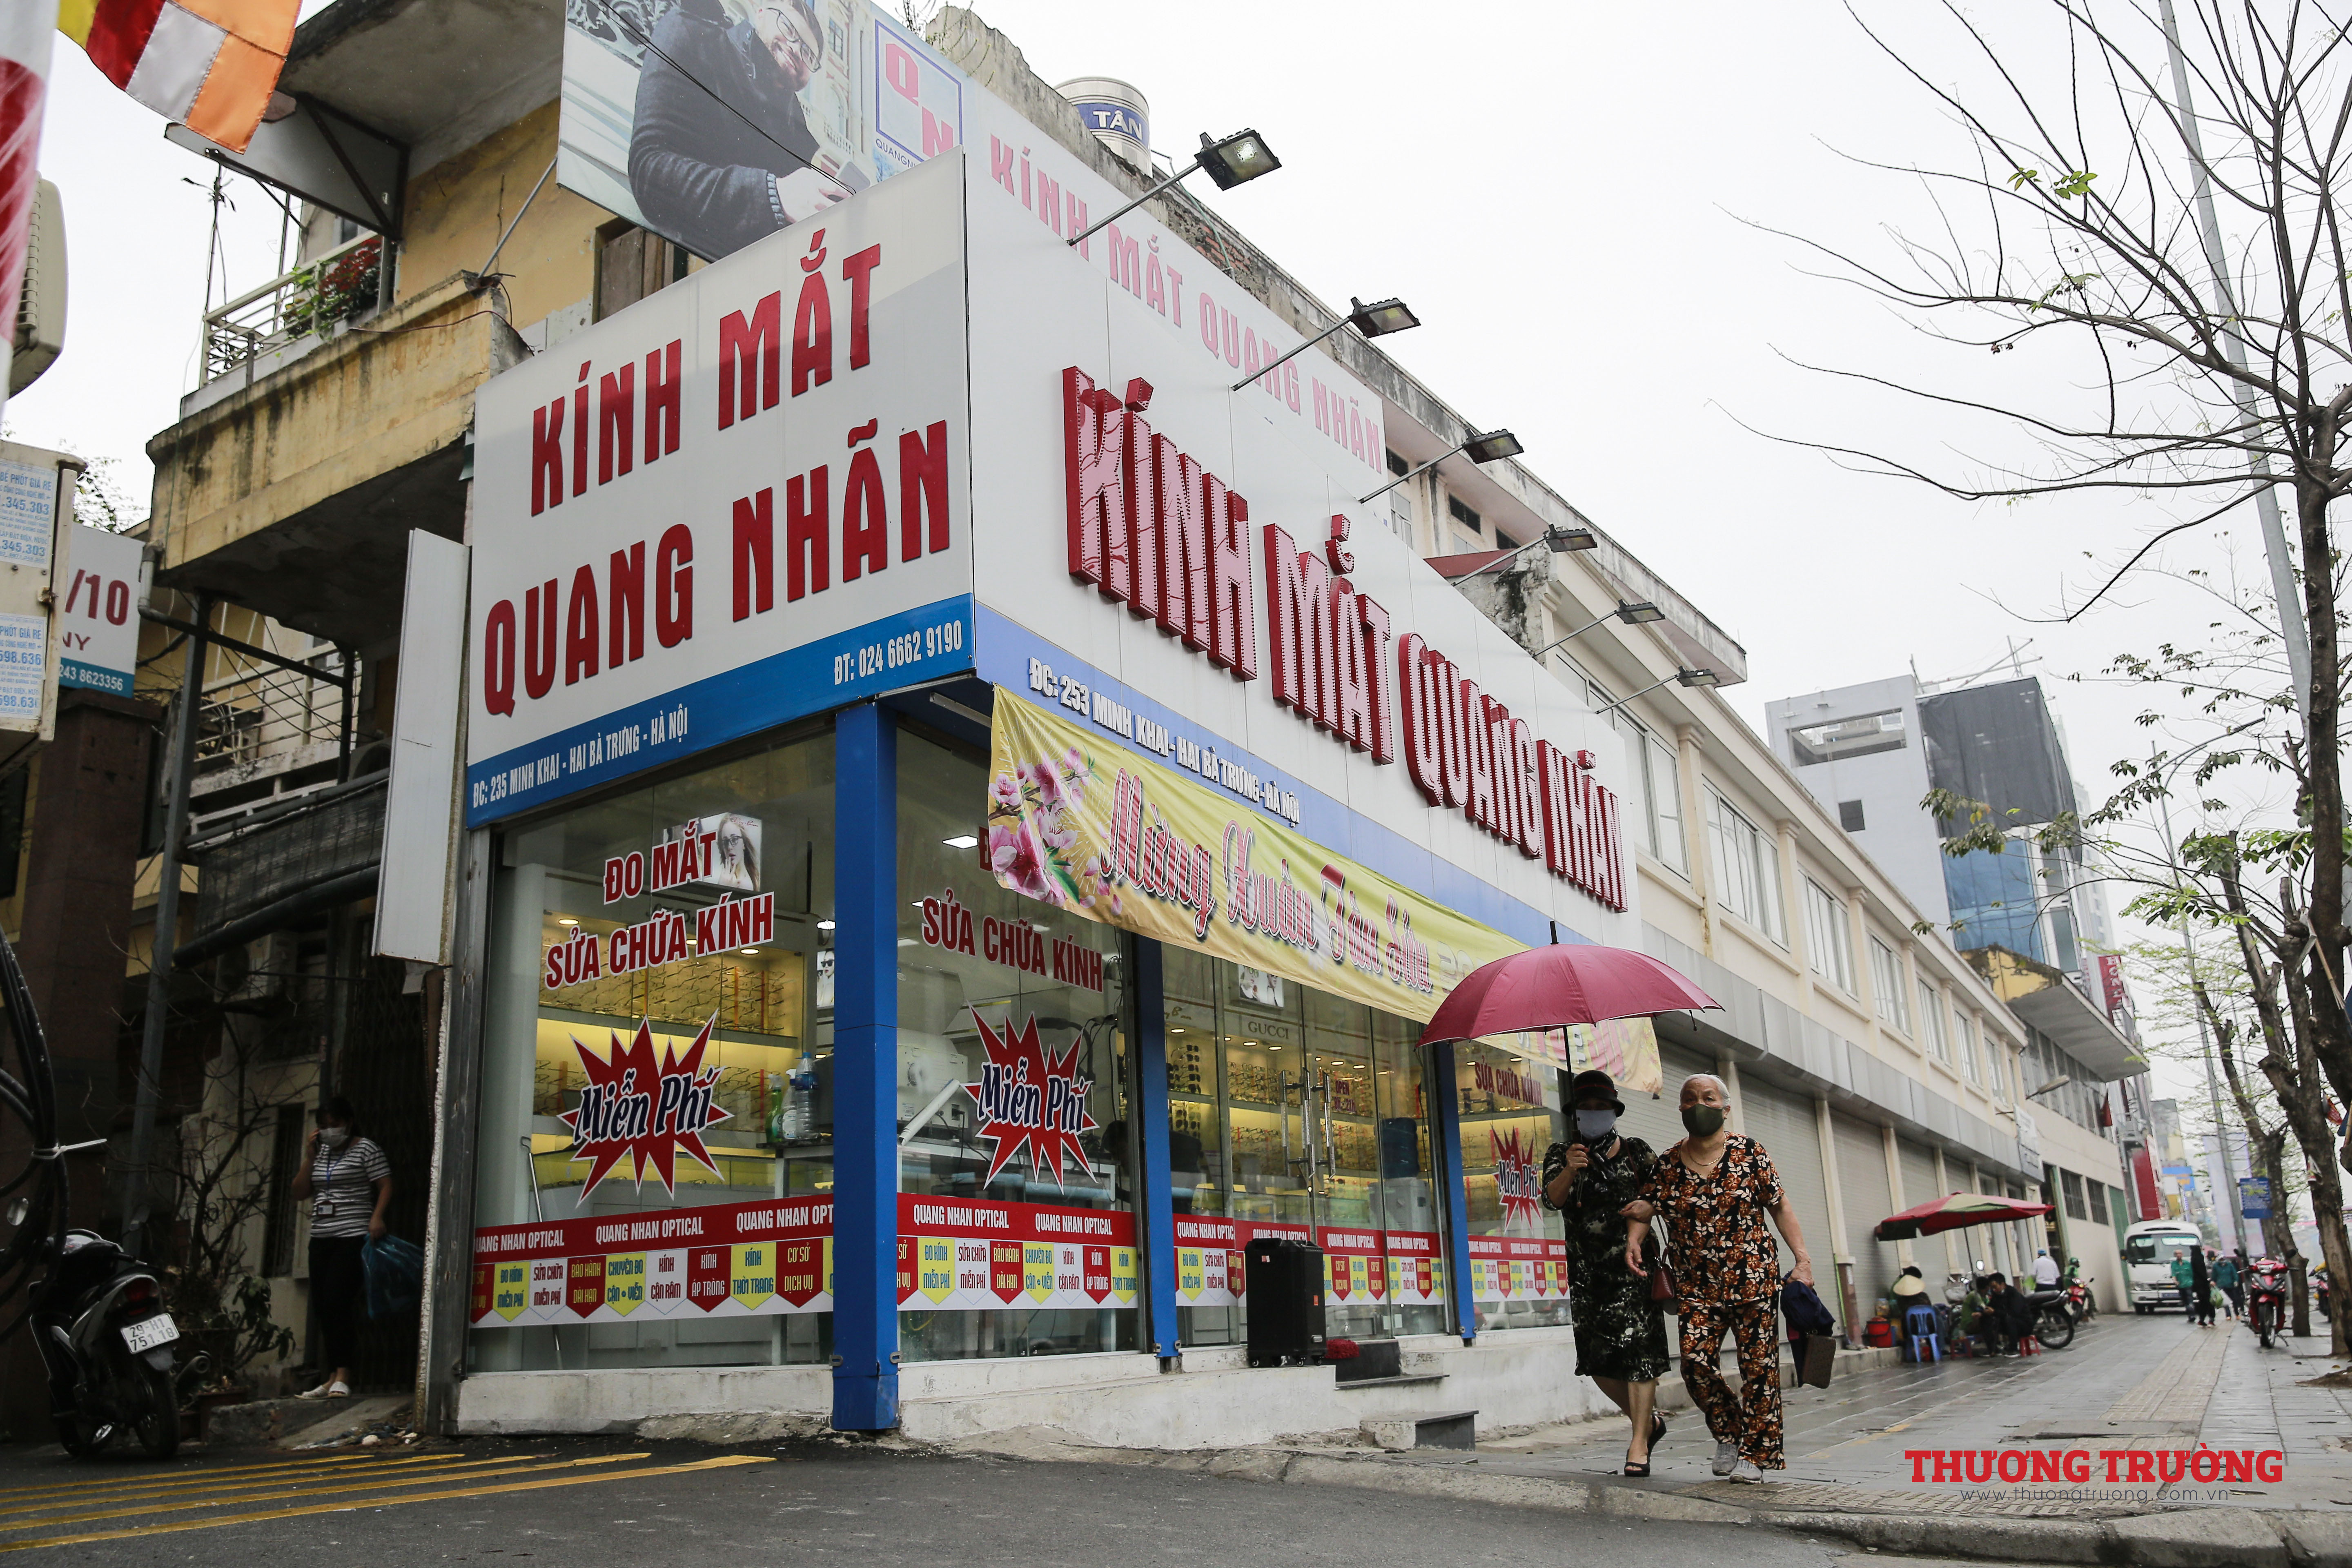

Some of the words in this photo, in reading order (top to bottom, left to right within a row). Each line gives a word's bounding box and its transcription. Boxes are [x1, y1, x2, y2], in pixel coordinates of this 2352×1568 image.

[1094, 110, 1143, 140] TÂN
[990, 133, 1089, 262] KÍNH
[1109, 220, 1183, 328] MẮT
[1199, 292, 1301, 416] QUANG
[1312, 374, 1382, 474] NHÃN
[531, 338, 681, 517] KÍNH
[719, 228, 881, 431] MẮT
[484, 523, 693, 717] QUANG
[733, 418, 950, 623] NHÃN
[1062, 365, 1257, 681] KÍNH
[1263, 514, 1394, 765] MẮT
[1398, 631, 1543, 860] QUANG
[1536, 739, 1628, 913] NHÃN
[834, 653, 854, 685] ĐT:
[859, 643, 883, 677] 024
[888, 631, 922, 669] 6662
[926, 620, 962, 657] 9190
[79, 668, 124, 692] 8623356
[1029, 657, 1058, 697] ĐC:
[1060, 675, 1090, 716] 253
[1092, 691, 1132, 739] MINH
[1201, 746, 1219, 783] BÀ
[1219, 758, 1260, 802] TRƯNG
[1280, 791, 1300, 827] NỘI
[473, 780, 488, 808] ĐC:
[490, 773, 507, 802] 235
[510, 762, 534, 795] MINH
[537, 753, 559, 786] KHAI
[570, 743, 586, 774] HAI
[589, 733, 603, 767] BÀ
[606, 724, 639, 761] TRƯNG
[651, 710, 665, 746] HÀ
[669, 703, 688, 742] NỘI
[604, 852, 644, 903] ĐO
[651, 819, 716, 892] MẮT
[1099, 768, 1214, 935] Mừng
[1222, 819, 1318, 951] Xuân
[1320, 863, 1382, 975] Tân
[1385, 894, 1433, 993] Sửu
[546, 927, 601, 989] SỬA
[609, 909, 688, 975] CHỮA
[697, 893, 774, 957] KÍNH
[922, 888, 976, 956] SỬA
[984, 915, 1046, 976] CHỮA
[1053, 935, 1102, 992] KÍNH
[1248, 1021, 1289, 1039] GUCCI
[1475, 1055, 1494, 1093] SỬA
[1496, 1068, 1521, 1101] CHỮA
[1521, 1072, 1543, 1106] KÍNH
[978, 1057, 1040, 1128] Miễn
[574, 1067, 650, 1145] Miễn
[1498, 1154, 1521, 1197] Miễn
[737, 1210, 773, 1233] QUANG
[777, 1206, 808, 1228] NHAN
[914, 1204, 945, 1225] QUANG
[947, 1207, 972, 1226] NHAN
[975, 1209, 1009, 1228] OPTICAL
[1036, 1213, 1060, 1232] QUANG
[1062, 1215, 1082, 1233] NHAN
[1085, 1217, 1112, 1235] OPTICAL
[501, 1233, 526, 1251] NHAN
[528, 1229, 564, 1248] OPTICAL
[596, 1224, 628, 1245] QUANG
[631, 1220, 659, 1240] NHAN
[662, 1217, 704, 1238] OPTICAL
[1177, 1222, 1198, 1238] QUANG
[1199, 1223, 1216, 1239] NHAN
[1327, 1233, 1343, 1248] QUANG
[1343, 1234, 1357, 1247] NHAN
[1357, 1235, 1375, 1248] OPTICAL
[701, 1251, 717, 1269] KÍNH
[745, 1248, 761, 1267] KÍNH
[788, 1247, 799, 1263] CƠ
[800, 1242, 811, 1262] SỞ
[925, 1245, 933, 1260] ĐO
[934, 1242, 947, 1261] KÍNH
[959, 1243, 970, 1261] SỬA
[971, 1245, 986, 1262] CHỮA
[993, 1244, 1004, 1263] BẢO
[1005, 1245, 1019, 1263] HÀNH
[1025, 1247, 1045, 1263] CHUYÊN
[1063, 1248, 1074, 1265] KÍNH
[1091, 1249, 1102, 1265] KÍNH
[534, 1263, 545, 1281] SỬA
[547, 1263, 563, 1280] CHỮA
[572, 1260, 584, 1278] BẢO
[585, 1260, 601, 1277] HÀNH
[608, 1258, 633, 1276] CHUYÊN
[659, 1254, 674, 1272] KÍNH
[692, 1279, 701, 1297] ÁP
[704, 1278, 725, 1296] TRÒNG
[733, 1276, 748, 1295] THỜI
[751, 1277, 773, 1294] TRANG
[784, 1274, 802, 1294] DỊCH
[804, 1274, 813, 1293] VỤ
[923, 1269, 938, 1288] MIỄN
[940, 1270, 950, 1288] PHÍ
[960, 1270, 975, 1289] MIỄN
[976, 1271, 985, 1288] PHÍ
[997, 1271, 1006, 1288] DÀI
[1007, 1274, 1017, 1291] HẠN
[1026, 1273, 1036, 1292] CẬN
[1042, 1272, 1052, 1289] VIỄN
[1059, 1274, 1068, 1292] CẬN
[1069, 1274, 1080, 1290] RÂM
[1087, 1273, 1093, 1290] ÁP
[1094, 1273, 1108, 1290] TRÒNG
[534, 1288, 549, 1306] MIỄN
[551, 1287, 562, 1305] PHÍ
[574, 1288, 584, 1303] DÀI
[585, 1288, 597, 1305] HẠN
[607, 1285, 619, 1304] CẬN
[628, 1282, 643, 1301] VIỄN
[651, 1283, 664, 1302] CẬN
[665, 1281, 681, 1299] RÂM
[129, 1318, 165, 1338] 29-H1
[130, 1327, 175, 1351] 751.18
